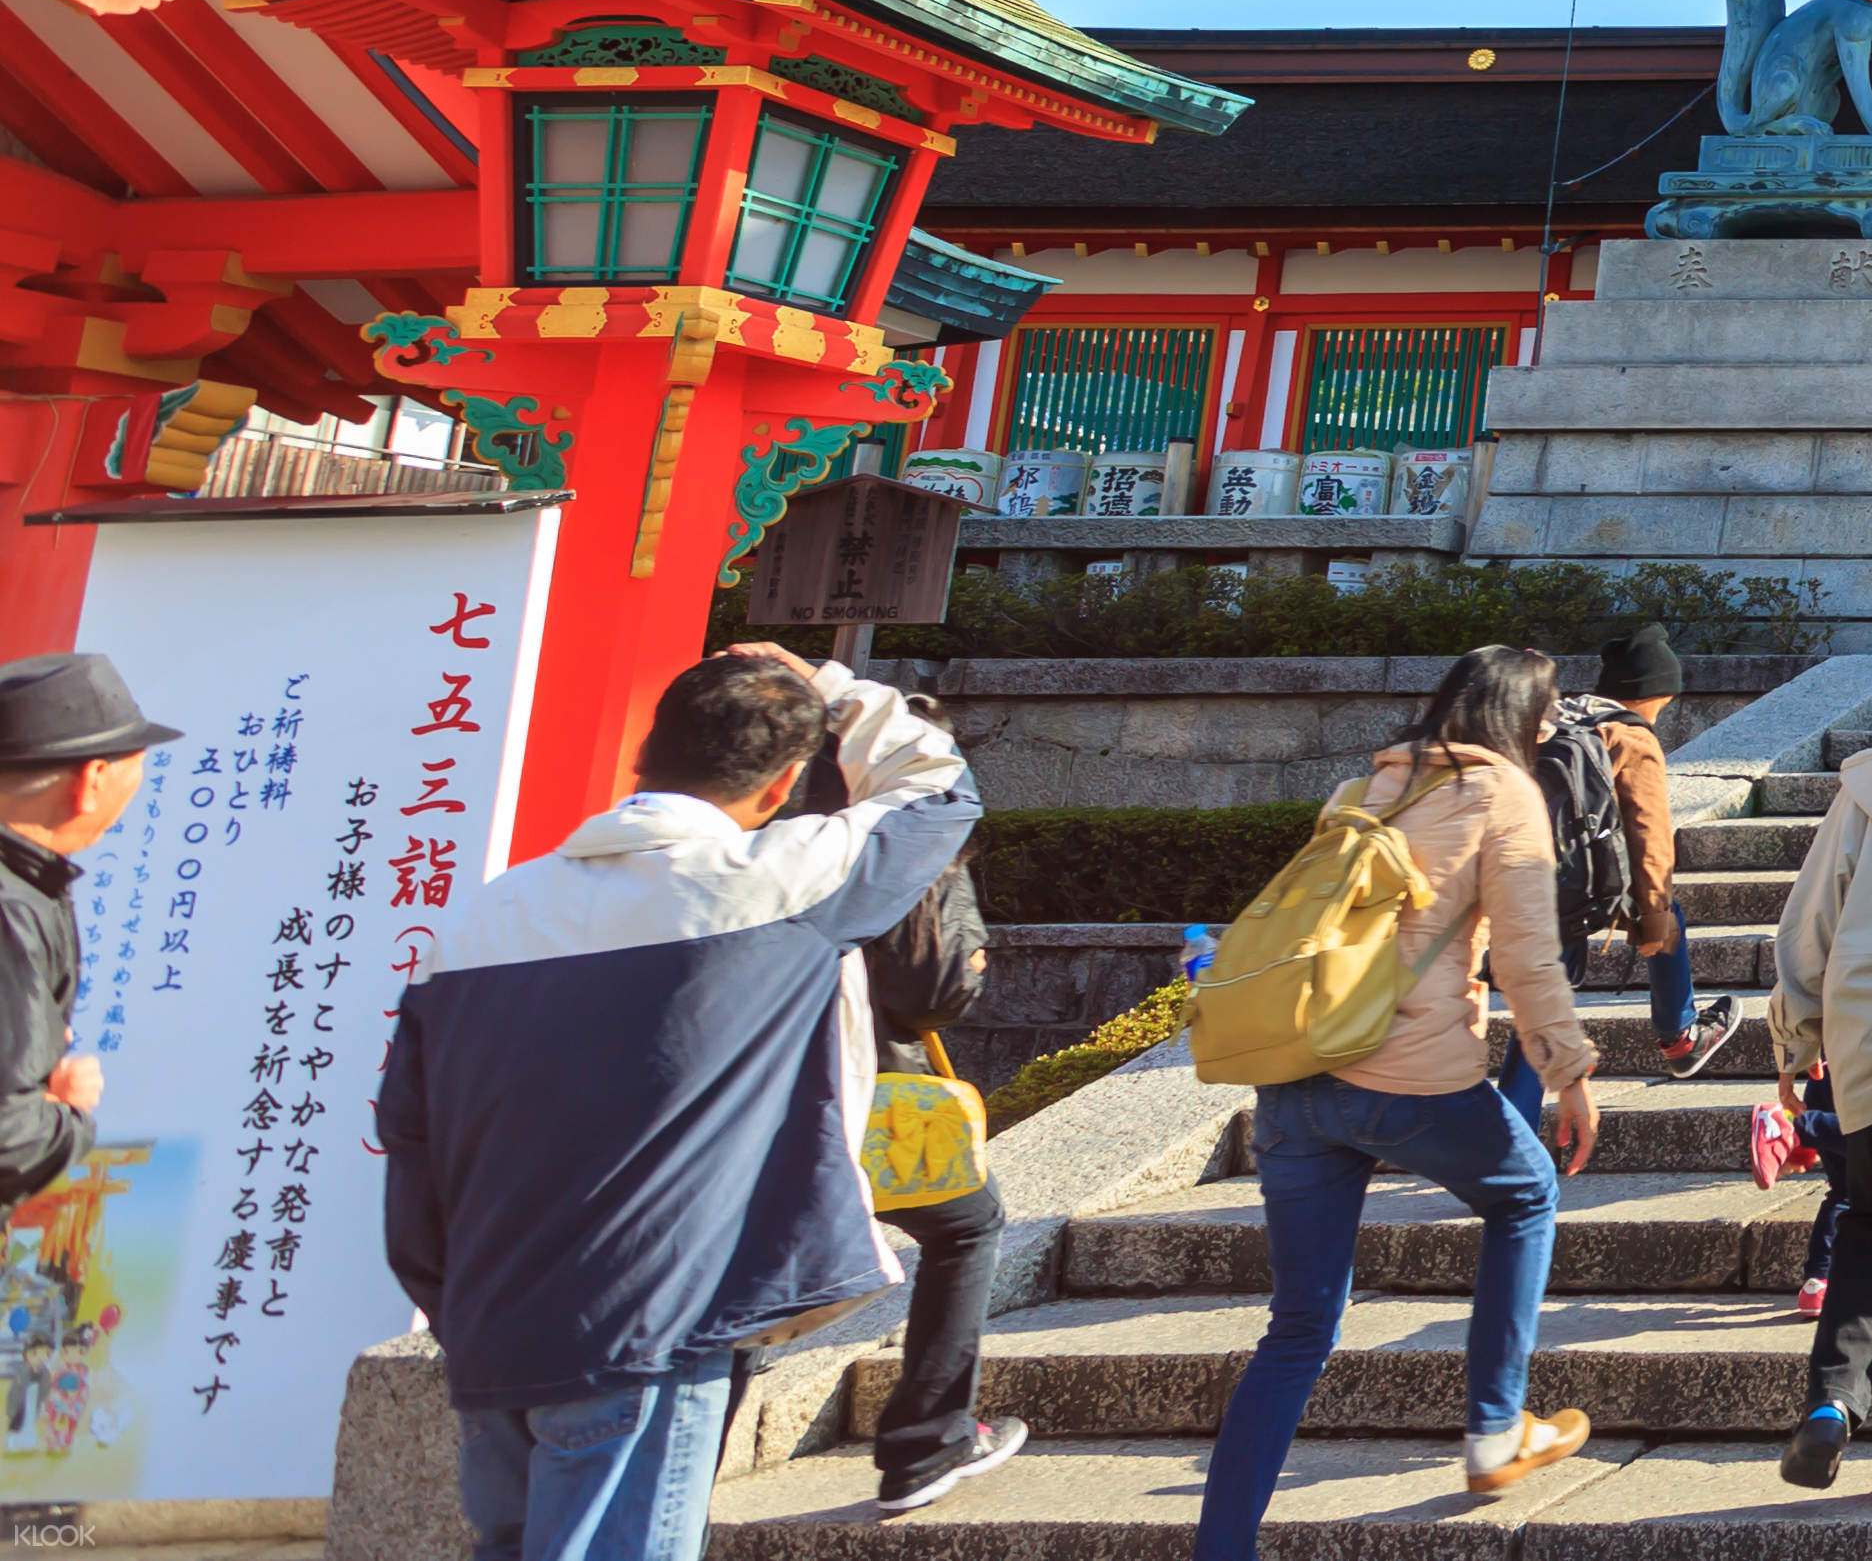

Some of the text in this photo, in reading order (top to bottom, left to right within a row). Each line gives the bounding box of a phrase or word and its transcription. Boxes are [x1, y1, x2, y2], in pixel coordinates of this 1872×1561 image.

[790, 606, 898, 620] NO SMOKING
[829, 531, 873, 600] 禁止
[225, 712, 265, 846] おひとり
[262, 777, 379, 1317] お子様のすこやかな発育と
[193, 907, 313, 1415] 成長を祈念する慶事です
